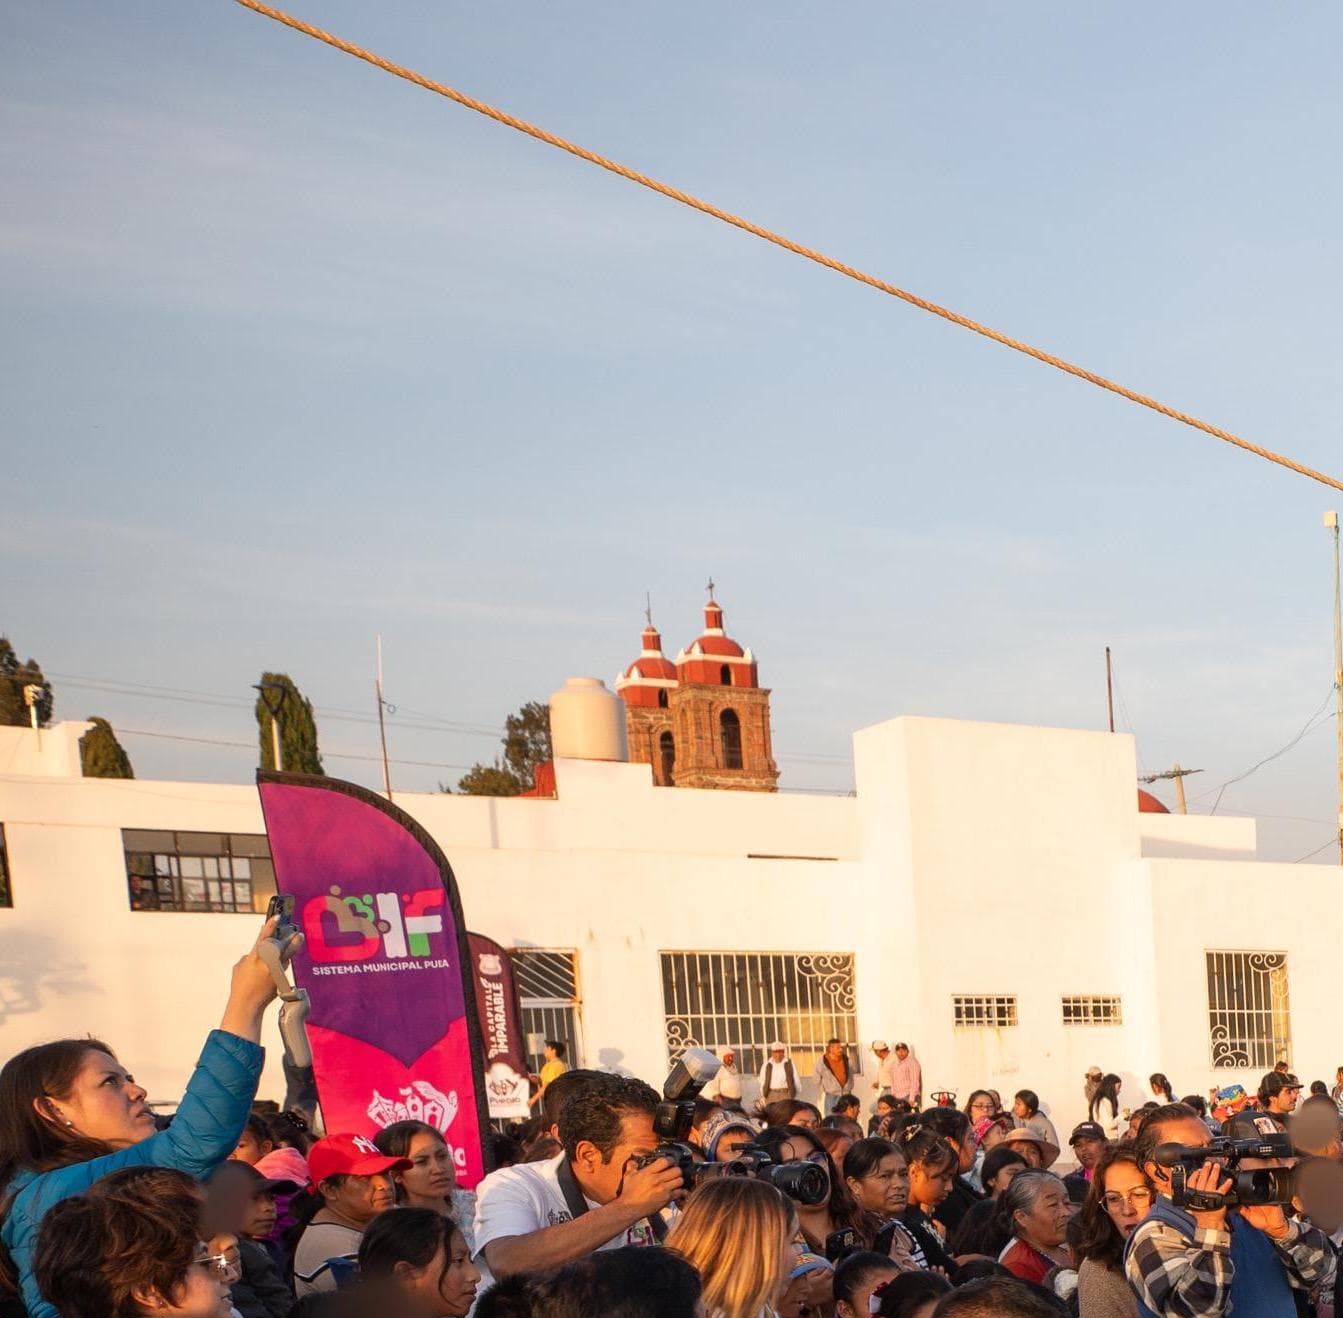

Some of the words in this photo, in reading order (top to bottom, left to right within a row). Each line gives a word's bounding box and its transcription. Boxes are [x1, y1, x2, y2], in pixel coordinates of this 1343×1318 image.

[312, 964, 362, 976] SISTEMA
[363, 961, 423, 973] MUNICIPAL
[485, 987, 496, 1032] CAPITAL
[492, 982, 509, 1053] IMPARABLE
